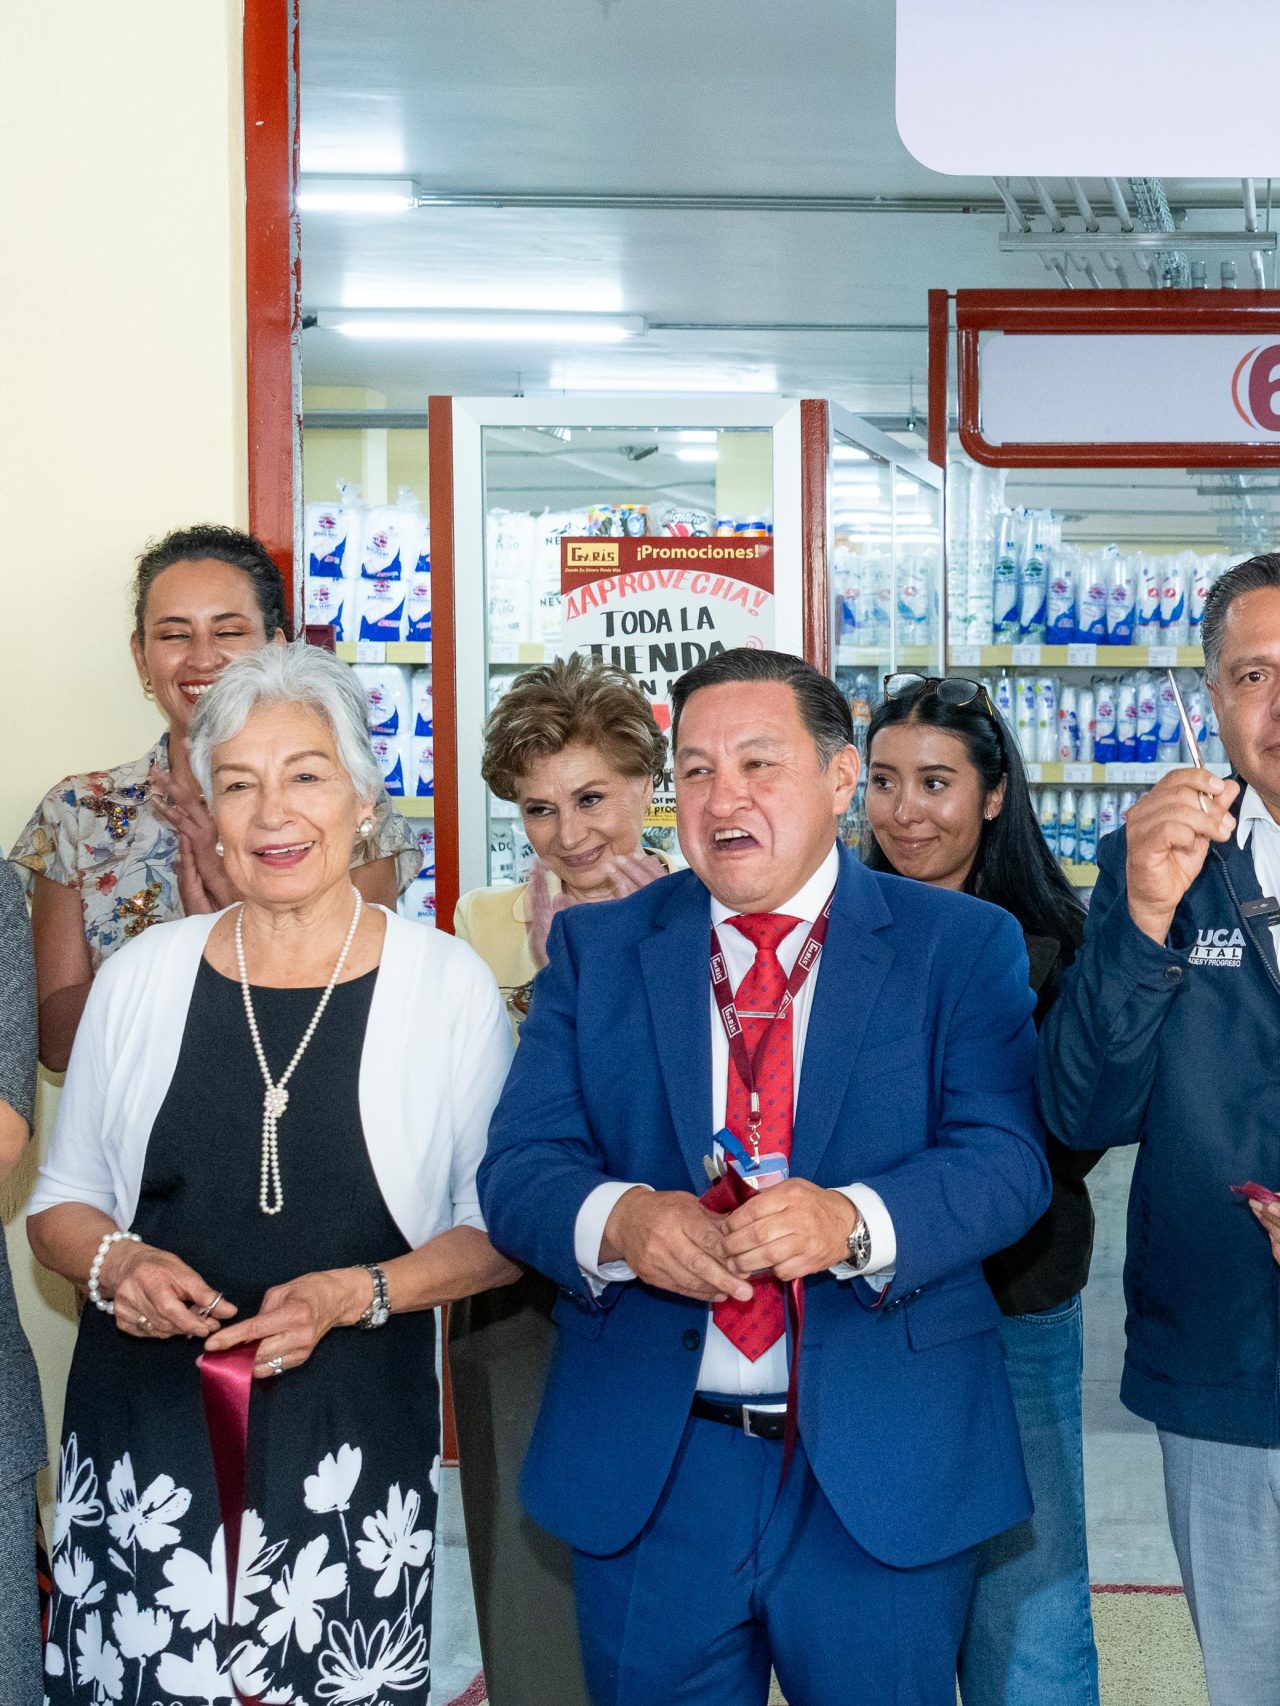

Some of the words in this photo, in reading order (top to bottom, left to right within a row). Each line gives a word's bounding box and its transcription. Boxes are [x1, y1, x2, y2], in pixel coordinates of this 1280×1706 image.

[637, 544, 760, 560] ¡Promociones!
[600, 607, 673, 637] TODA
[680, 606, 715, 631] LA
[1196, 927, 1247, 947] UCA
[1194, 947, 1239, 958] ITAL
